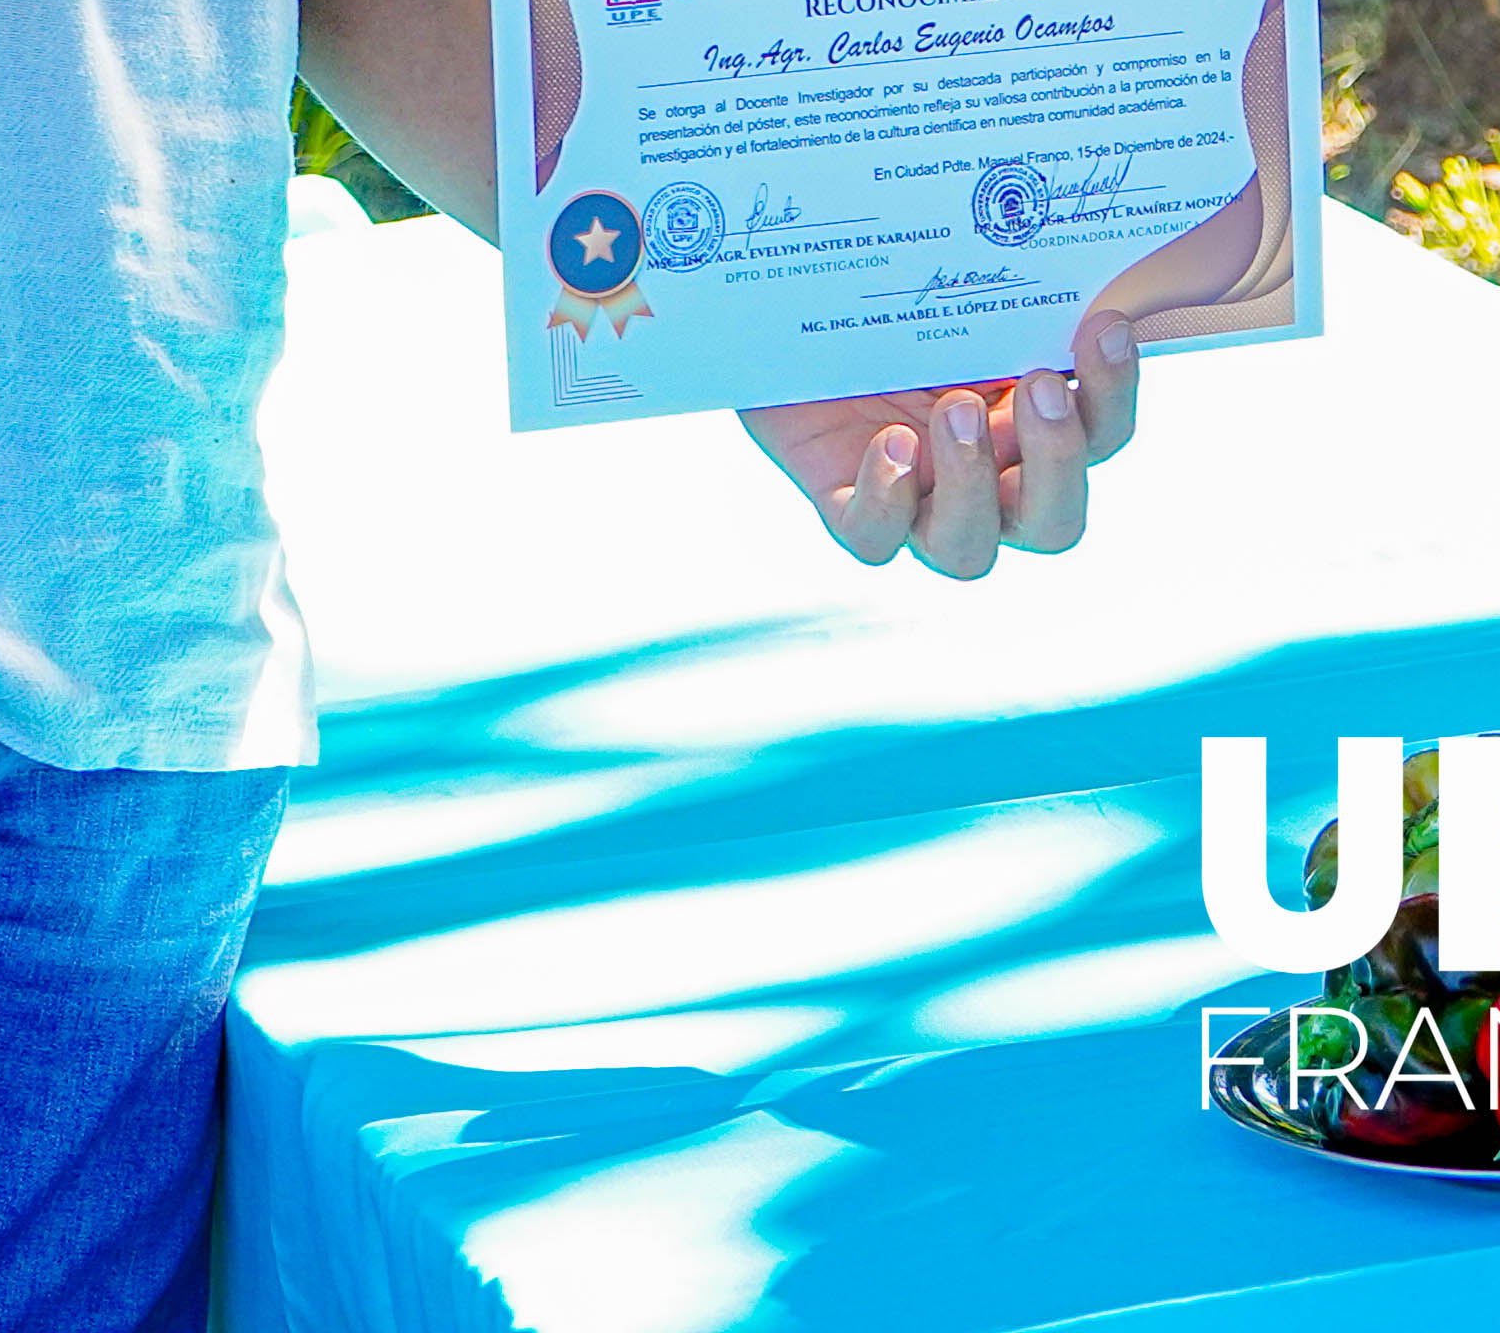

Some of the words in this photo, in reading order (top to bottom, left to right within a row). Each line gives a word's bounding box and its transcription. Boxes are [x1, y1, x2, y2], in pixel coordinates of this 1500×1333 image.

[612, 8, 659, 22] UPE
[827, 30, 903, 65] Carlos
[915, 22, 1005, 56] Eugenio
[1015, 13, 1116, 43] Ocampos
[638, 108, 656, 121] Se
[665, 104, 706, 120] otorga
[715, 100, 727, 114] al
[736, 95, 789, 111] Docente
[797, 84, 875, 107] Investigador
[883, 84, 904, 99] por
[912, 81, 929, 93] su
[938, 73, 1001, 91] destacada
[1010, 63, 1087, 86] participación
[1096, 64, 1104, 77] y
[1112, 53, 1187, 74] compromiso
[1195, 51, 1212, 64] en
[1219, 48, 1231, 61] la
[639, 123, 720, 145] presentación
[724, 119, 743, 135] del
[746, 115, 790, 134] póster,
[793, 113, 821, 128] este
[825, 102, 920, 123] reconocimiento
[923, 98, 961, 114] refleja
[965, 97, 981, 109] su
[984, 91, 1027, 107] valiosa
[1031, 82, 1105, 103] contribución
[1108, 84, 1117, 94] a
[1119, 80, 1132, 93] la
[1134, 74, 1198, 94] promoción
[1201, 71, 1217, 84] de
[1220, 69, 1232, 82] la
[640, 144, 722, 165] investigación
[724, 147, 732, 159] y
[736, 140, 747, 155] el
[750, 132, 841, 154] fortalecimiento
[844, 130, 861, 144] de
[863, 128, 875, 142] la
[878, 124, 920, 140] cultura
[923, 118, 977, 135] científica
[980, 117, 996, 129] en
[999, 111, 1045, 127] nuestra
[1048, 104, 1115, 122] comunidad
[1118, 96, 1187, 115] académica.
[874, 166, 892, 182] En
[894, 161, 939, 180] Ciudad
[942, 159, 975, 175] Pdte.
[978, 151, 1024, 170] Manuel
[1027, 146, 1074, 165] Franco,
[1114, 137, 1175, 156] Diciembre
[1178, 135, 1194, 148] de
[1196, 131, 1235, 148] 2024.-
[1070, 208, 1108, 224] DAISY
[1125, 198, 1183, 217] RAMÍREZ
[1185, 192, 1243, 211] MONZÓN
[714, 249, 745, 264] AGR.
[749, 242, 801, 261] EVELYN
[804, 237, 853, 254] PASTER
[855, 235, 874, 247] DE
[876, 226, 951, 245] KARAJALLO
[1019, 229, 1124, 251] COORDINADORA
[1127, 218, 1201, 239] ACADÉMICA
[767, 267, 783, 280] DE
[787, 254, 890, 277] INVESTIGACIÓN
[801, 320, 828, 334] MG.
[829, 316, 858, 332] ING.
[861, 313, 894, 328] AMB.
[896, 307, 939, 323] MABEL
[942, 306, 954, 317] E.
[957, 300, 999, 317] LÓPEZ
[1001, 299, 1020, 311] DE
[1022, 291, 1081, 308] GARCETE
[916, 326, 969, 341] DECANA
